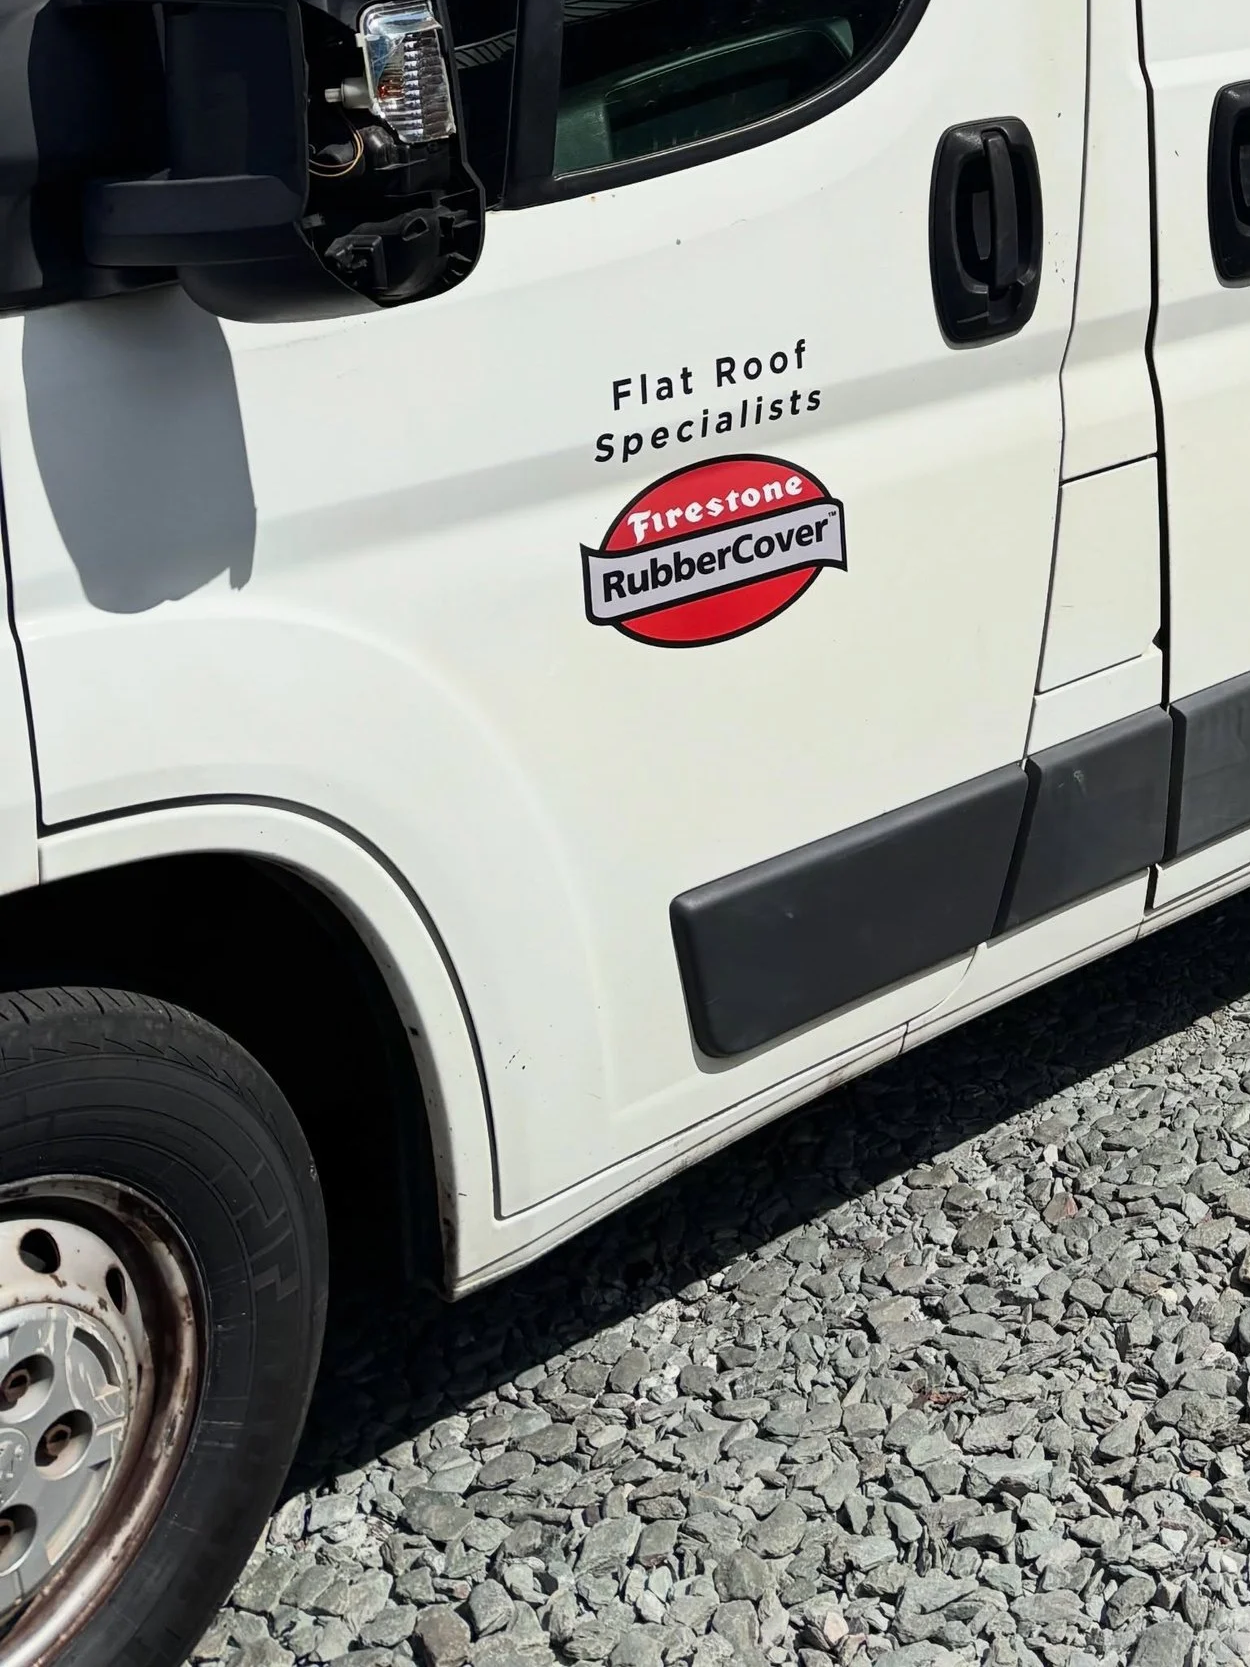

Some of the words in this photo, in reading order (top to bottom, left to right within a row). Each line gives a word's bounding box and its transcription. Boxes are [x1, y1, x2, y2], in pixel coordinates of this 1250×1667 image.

[612, 366, 693, 411] Flat
[715, 338, 806, 388] Roof
[594, 389, 821, 464] Specialists
[627, 474, 803, 545] Firestone
[602, 516, 829, 603] RubberCover
